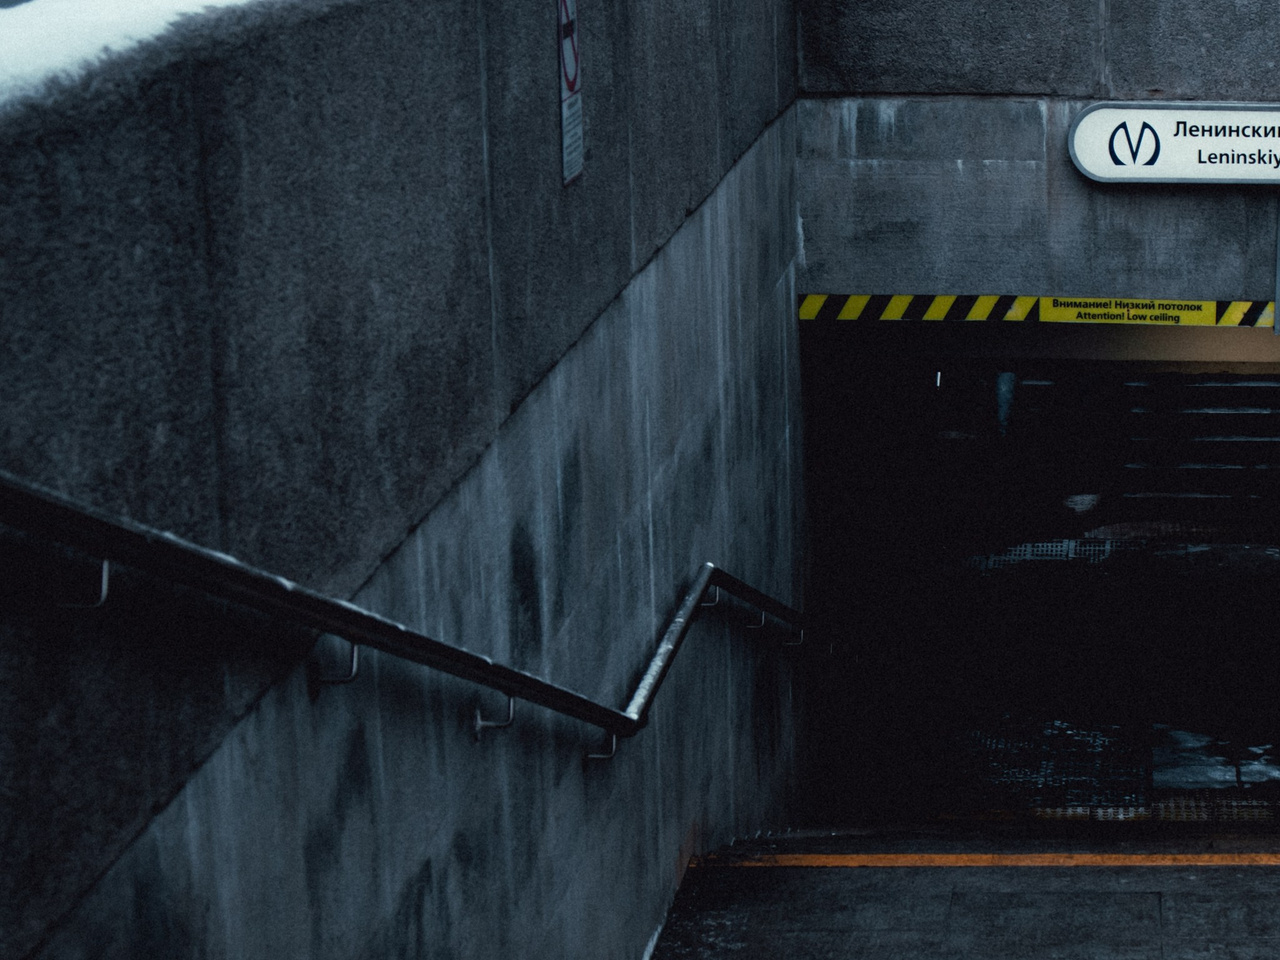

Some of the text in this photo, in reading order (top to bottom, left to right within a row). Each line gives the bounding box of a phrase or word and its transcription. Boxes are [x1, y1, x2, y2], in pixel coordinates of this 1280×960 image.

[1052, 299, 1203, 312] Внимание! Низкий потолок
[1076, 311, 1181, 323] Attention! Low ceiling
